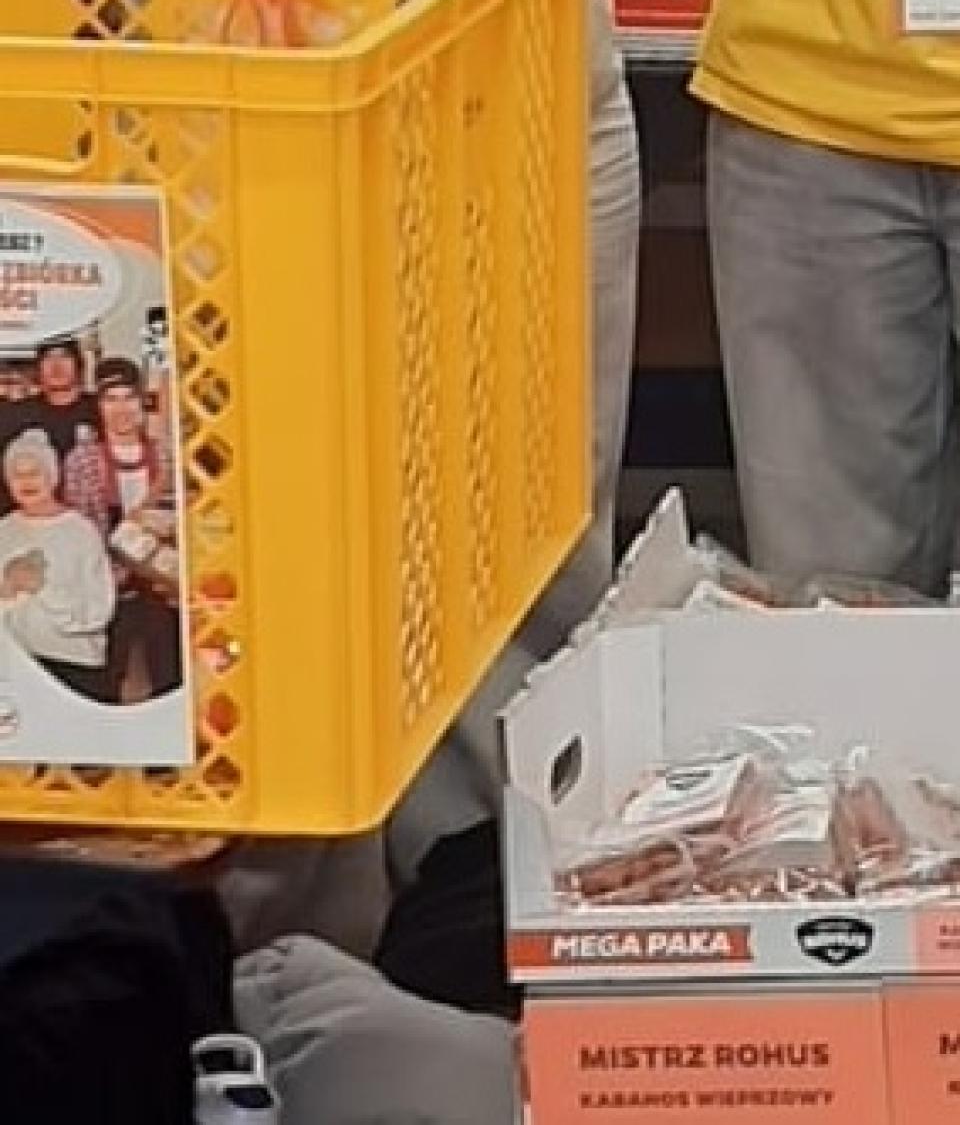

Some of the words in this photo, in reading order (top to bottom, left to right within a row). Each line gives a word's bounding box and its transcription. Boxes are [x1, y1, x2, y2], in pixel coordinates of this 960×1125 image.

[553, 931, 640, 958] MEGA
[648, 930, 732, 957] PAKA
[579, 1043, 706, 1069] MISTRZ
[714, 1042, 830, 1067] ROHUS
